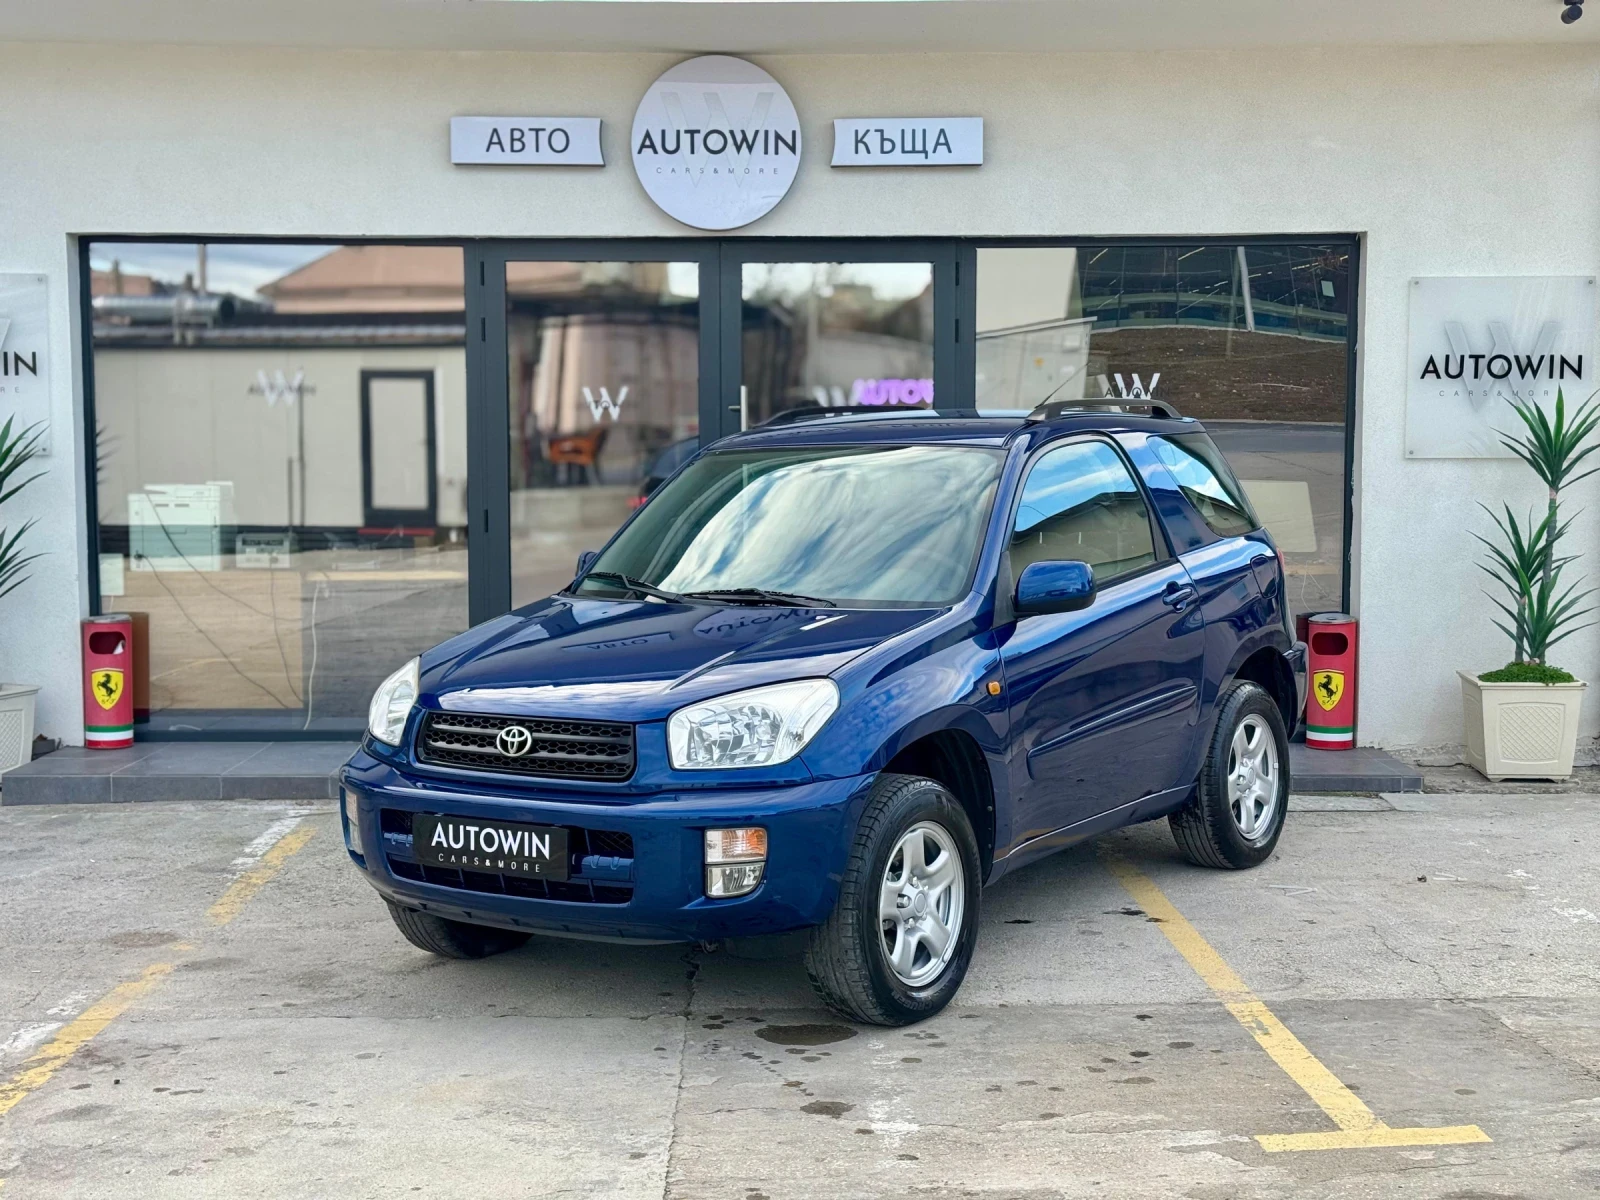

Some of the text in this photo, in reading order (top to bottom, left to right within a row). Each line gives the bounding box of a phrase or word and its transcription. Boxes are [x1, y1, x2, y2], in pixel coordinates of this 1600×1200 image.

[485, 127, 570, 153] АВТО
[636, 128, 798, 156] AUTOWIN
[854, 128, 953, 159] КЪЩА
[656, 167, 779, 175] CARS&MORE
[1419, 353, 1583, 380] AUTOWIN
[1438, 389, 1549, 397] CARS&MOR
[431, 822, 550, 861] AUTOWIN
[438, 853, 541, 873] CARS&MORE
